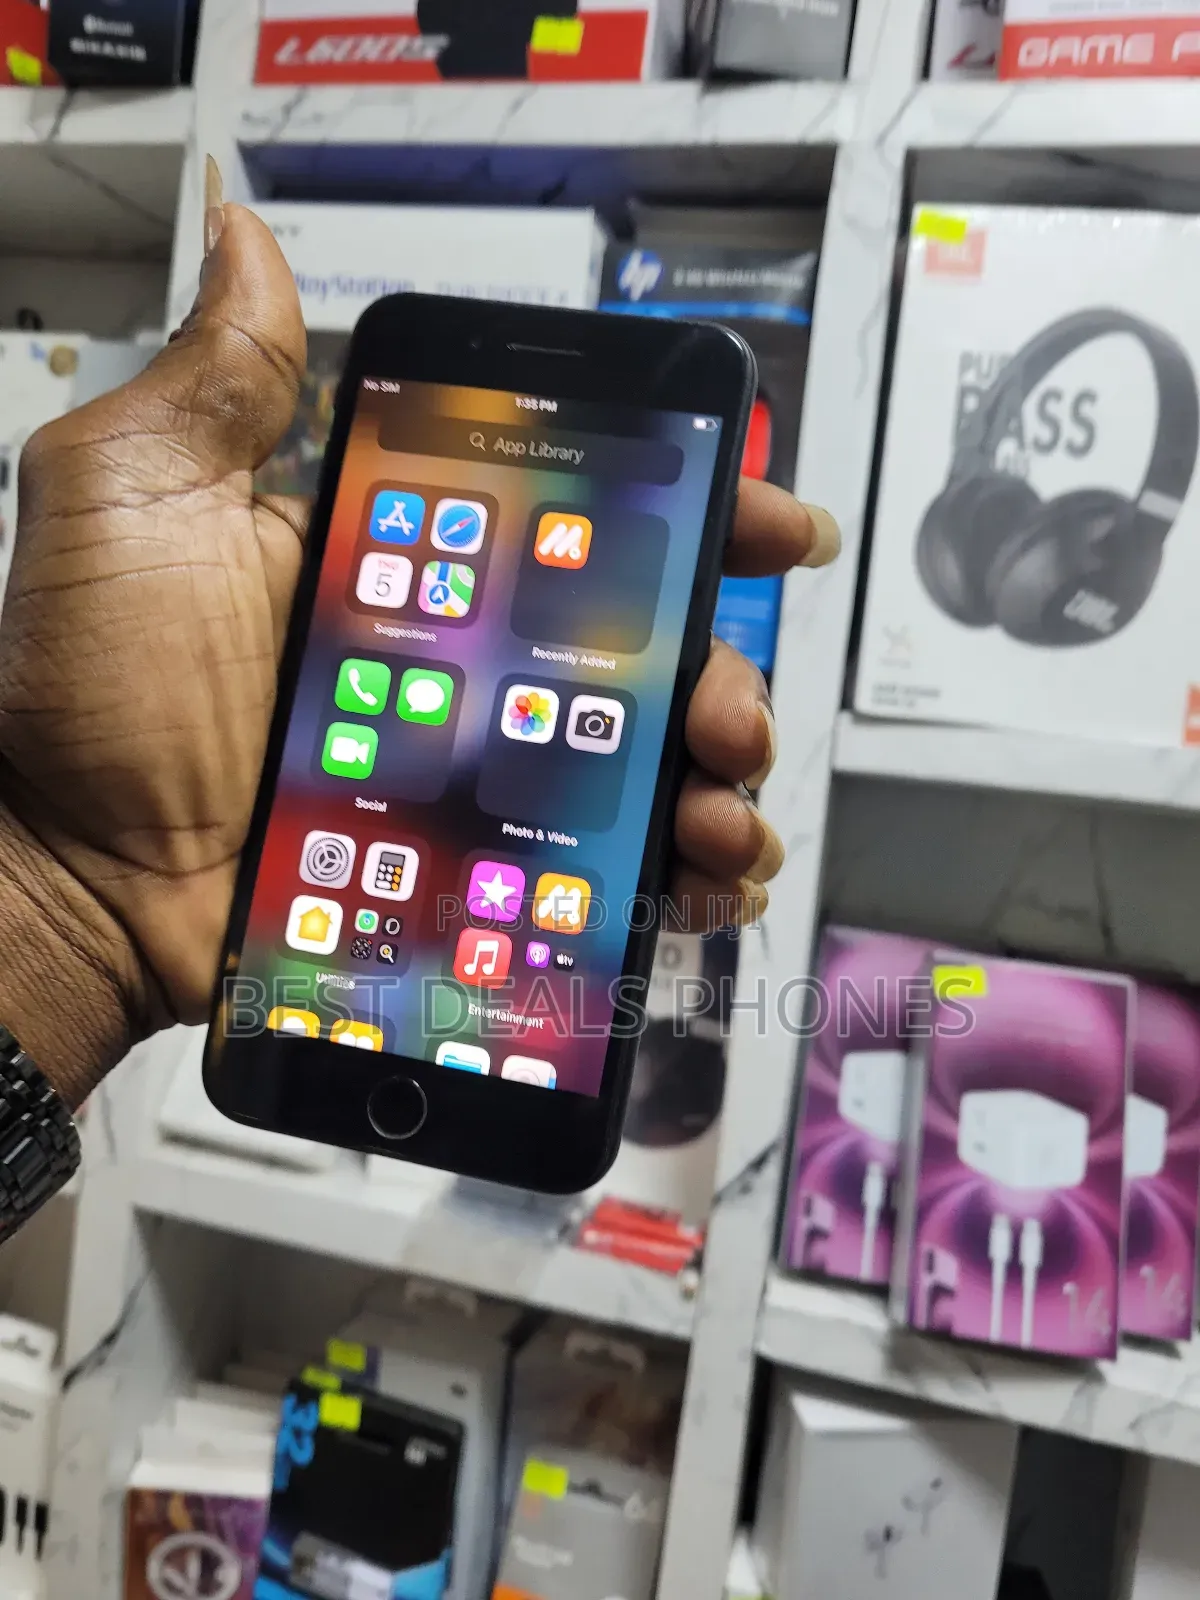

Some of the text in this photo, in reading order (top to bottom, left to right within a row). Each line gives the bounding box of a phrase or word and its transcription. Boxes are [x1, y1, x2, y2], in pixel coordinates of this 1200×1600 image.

[1017, 34, 1155, 68] GAME
[618, 249, 663, 302] hp
[380, 380, 401, 395] SIM
[538, 398, 558, 413] PM
[493, 436, 585, 466] App Library
[374, 572, 393, 598] 5
[373, 622, 438, 643] Suggestions
[532, 645, 617, 671] Recently Added
[354, 796, 388, 813] Social
[502, 822, 578, 848] Photo & Video
[315, 971, 356, 991] Utilities
[468, 1002, 545, 1030] Entertainment
